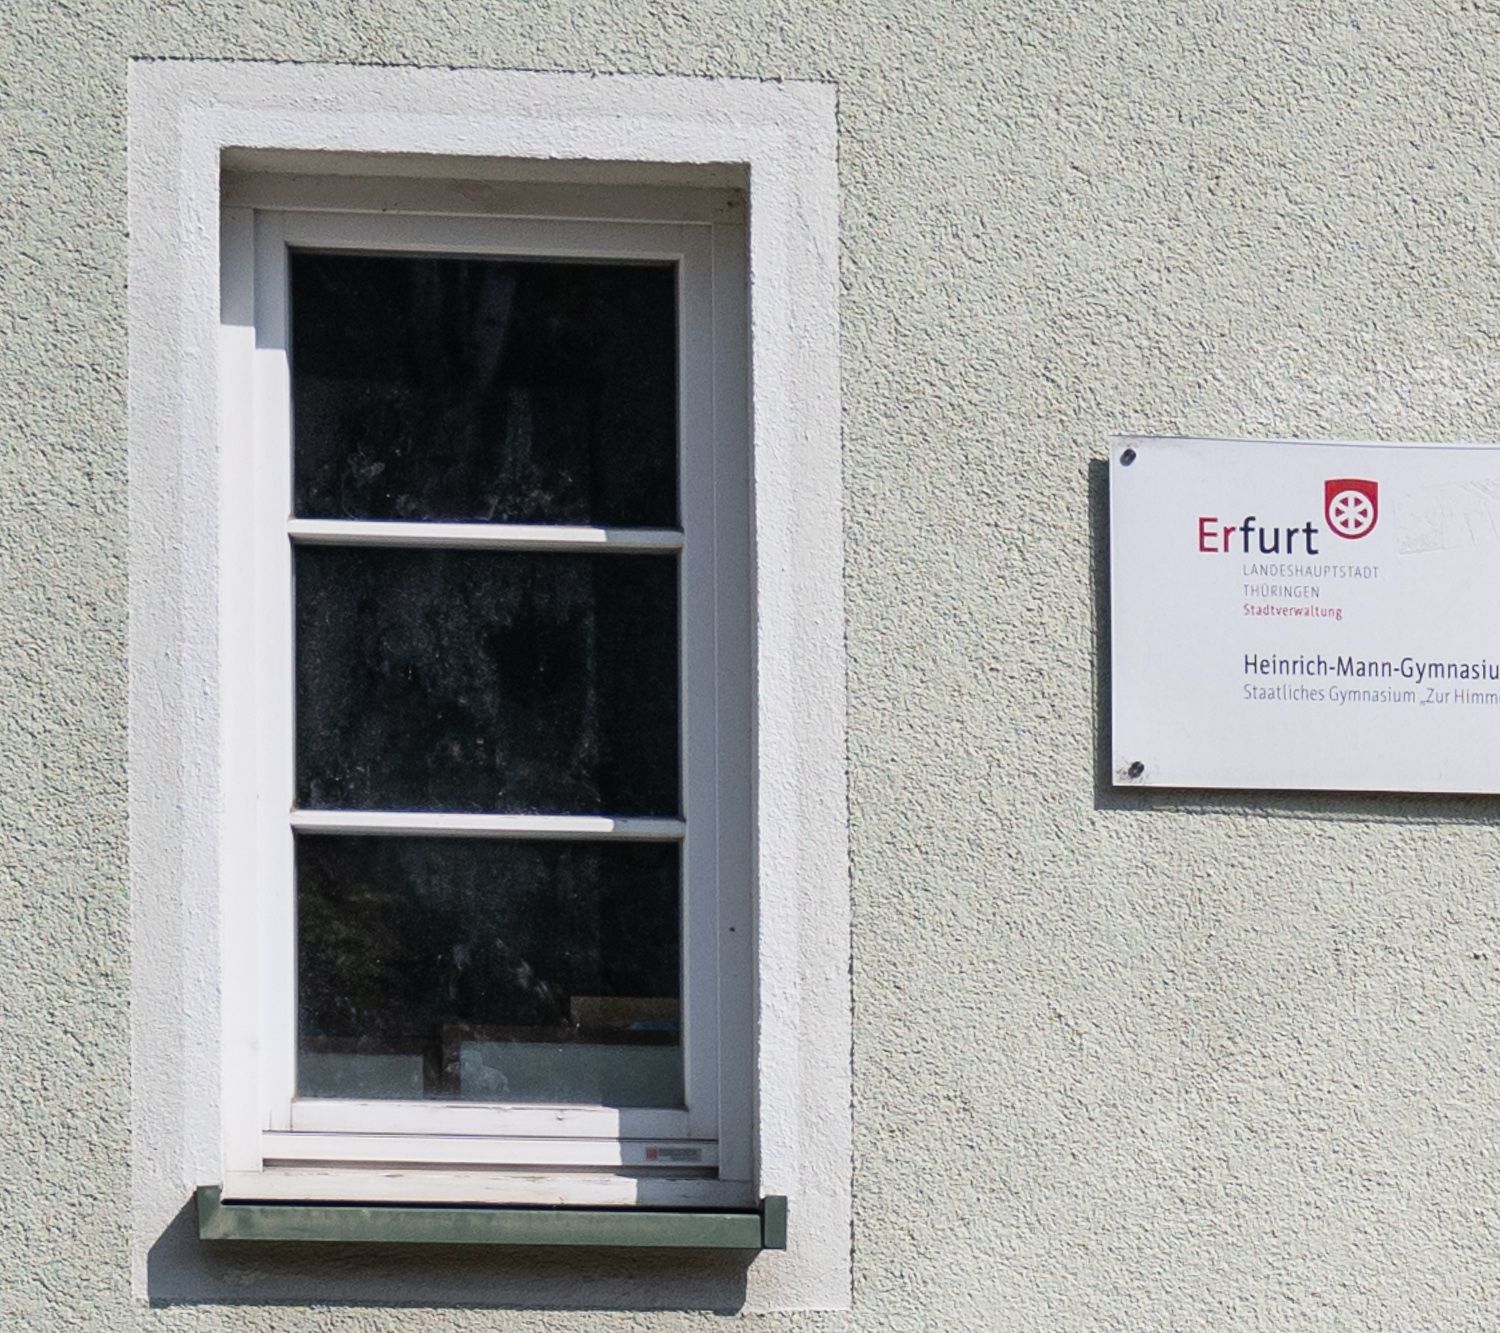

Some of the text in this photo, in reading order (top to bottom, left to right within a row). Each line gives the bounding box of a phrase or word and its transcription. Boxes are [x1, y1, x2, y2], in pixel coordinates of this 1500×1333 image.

[1198, 515, 1319, 555] Erfurt
[1243, 563, 1380, 580] LANDESHAUPTSTADT
[1243, 583, 1320, 599] THÜRINGEN
[1243, 603, 1343, 621] Stadtverwaltung
[1243, 684, 1326, 702] Staatliches
[1329, 686, 1416, 706] Gymnasium
